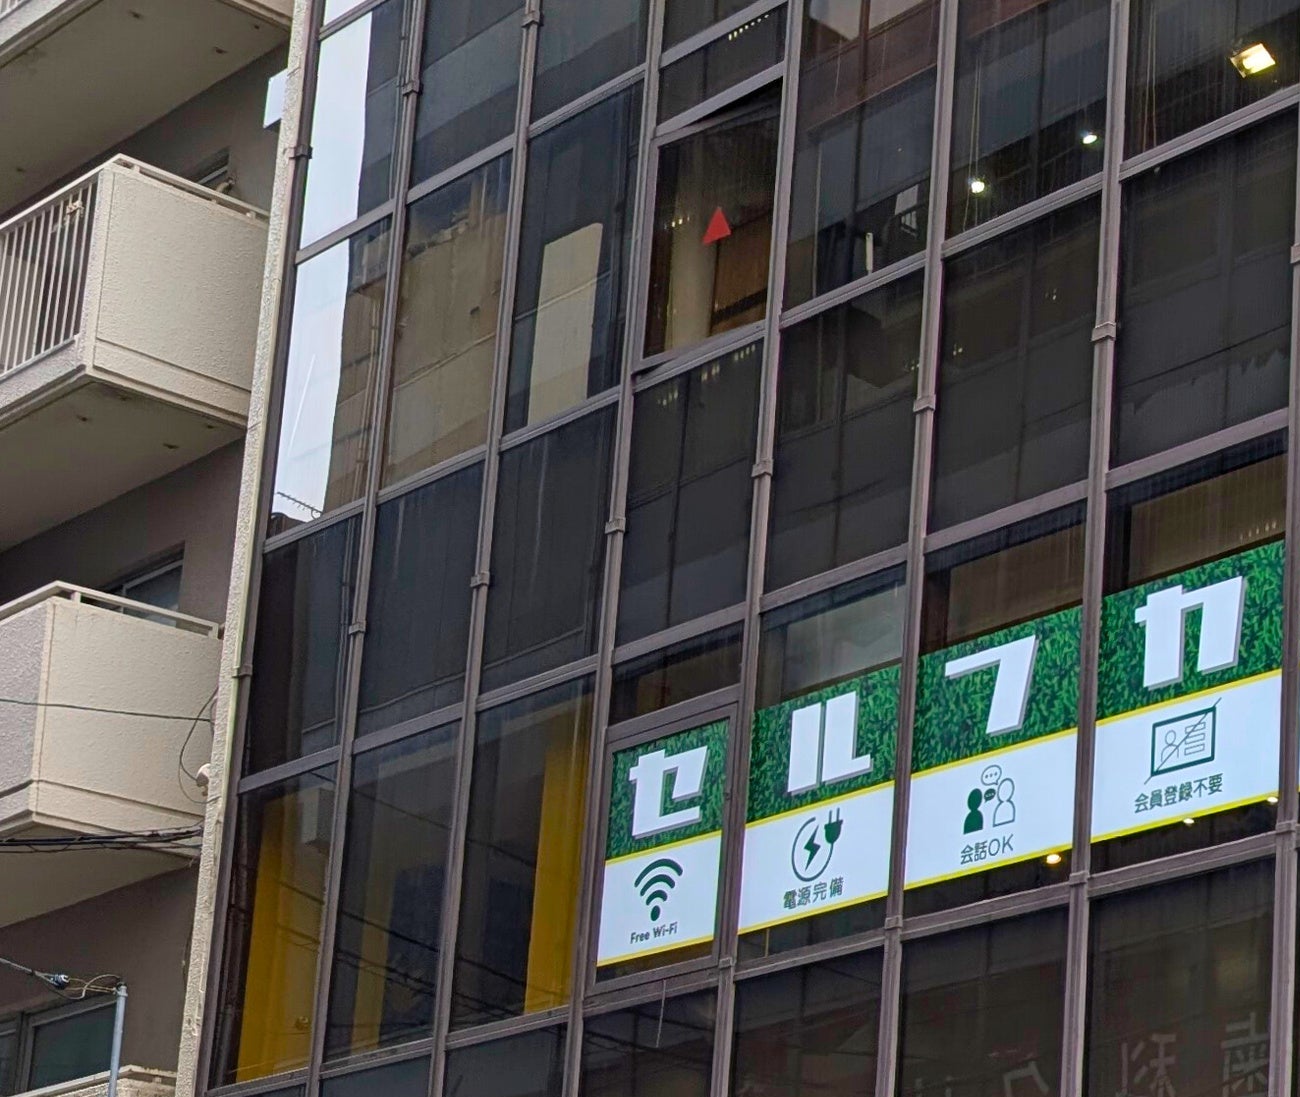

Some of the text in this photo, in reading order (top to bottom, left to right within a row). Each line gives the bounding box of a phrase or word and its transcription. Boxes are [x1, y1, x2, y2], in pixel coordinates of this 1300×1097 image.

[1134, 773, 1224, 814] 会員登録不要
[960, 834, 1014, 866] 会話OK
[783, 876, 844, 911] 電源完備
[630, 921, 679, 944] Free Wi-Fi
